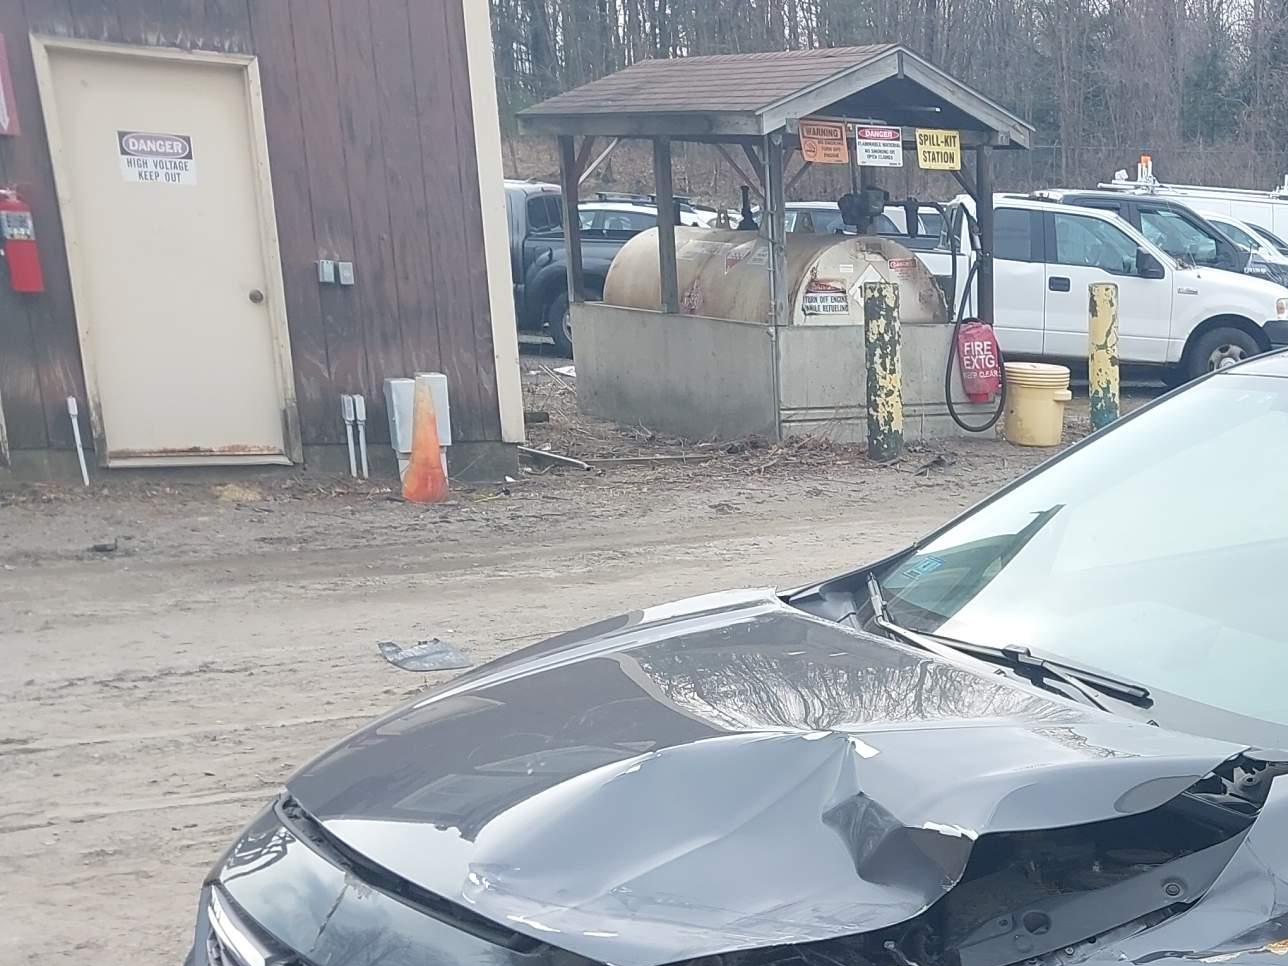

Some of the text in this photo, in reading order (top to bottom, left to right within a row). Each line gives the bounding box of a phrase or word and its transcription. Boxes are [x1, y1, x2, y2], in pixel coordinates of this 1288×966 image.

[805, 127, 839, 138] WARNING
[865, 130, 893, 139] DANGER
[128, 138, 183, 153] DANGER
[918, 133, 957, 147] SPILL-KIT
[922, 150, 955, 163] STATION
[126, 158, 189, 171] HIGH VOLTAGE
[138, 171, 181, 182] KEEP OUT
[804, 295, 818, 304] TURN
[820, 296, 829, 304] OFF
[822, 304, 849, 312] REFUELING
[964, 341, 992, 355] FIRE
[963, 355, 999, 369] EXTG.
